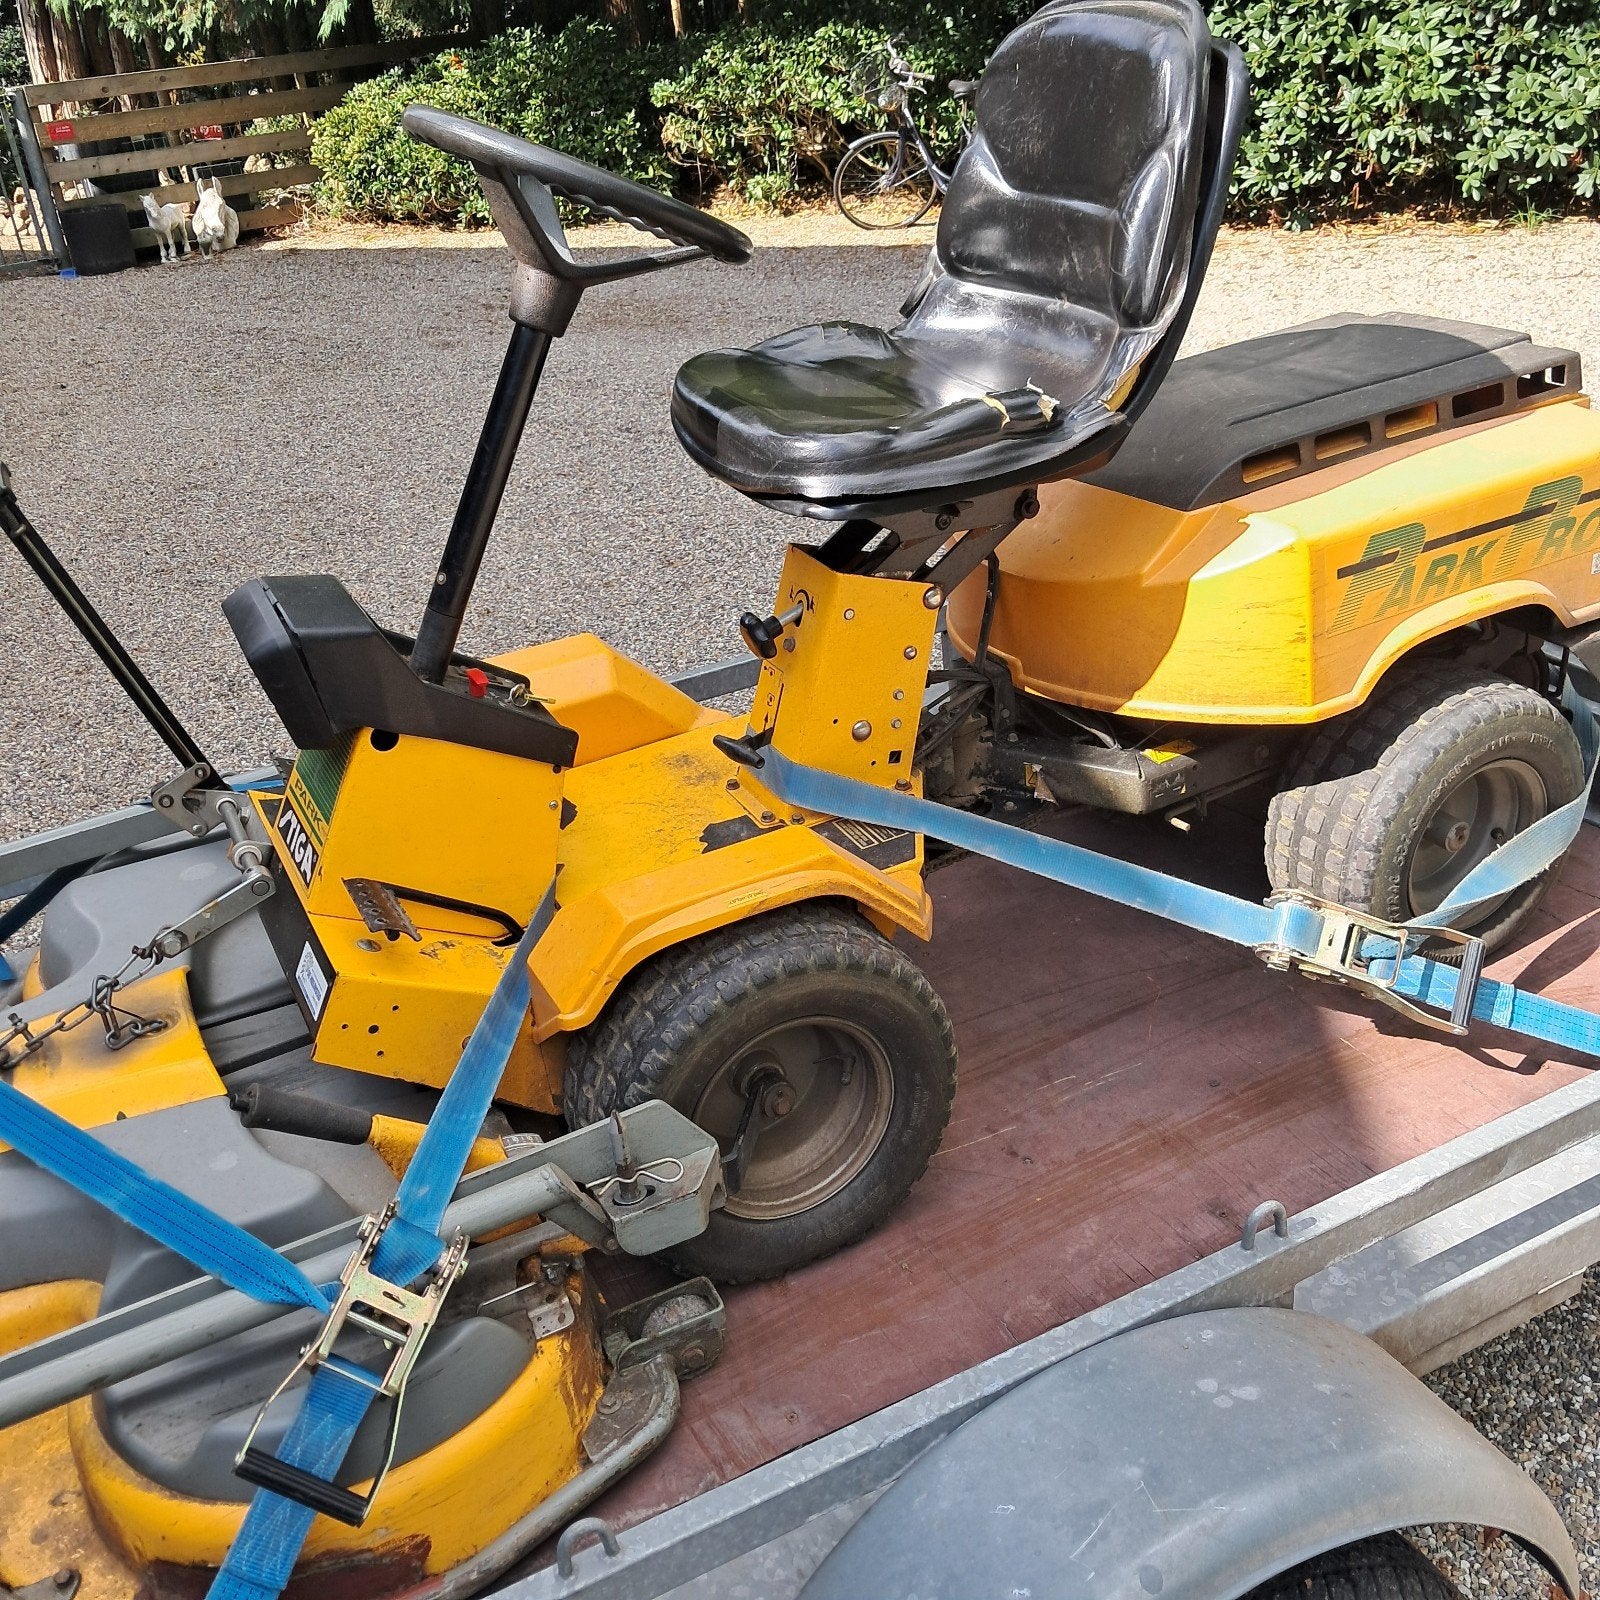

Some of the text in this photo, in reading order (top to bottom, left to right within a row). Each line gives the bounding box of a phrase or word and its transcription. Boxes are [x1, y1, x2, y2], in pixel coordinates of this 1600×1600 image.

[1326, 522, 1500, 635] PARK
[295, 778, 323, 832] PARK
[279, 810, 314, 884] STIGA
